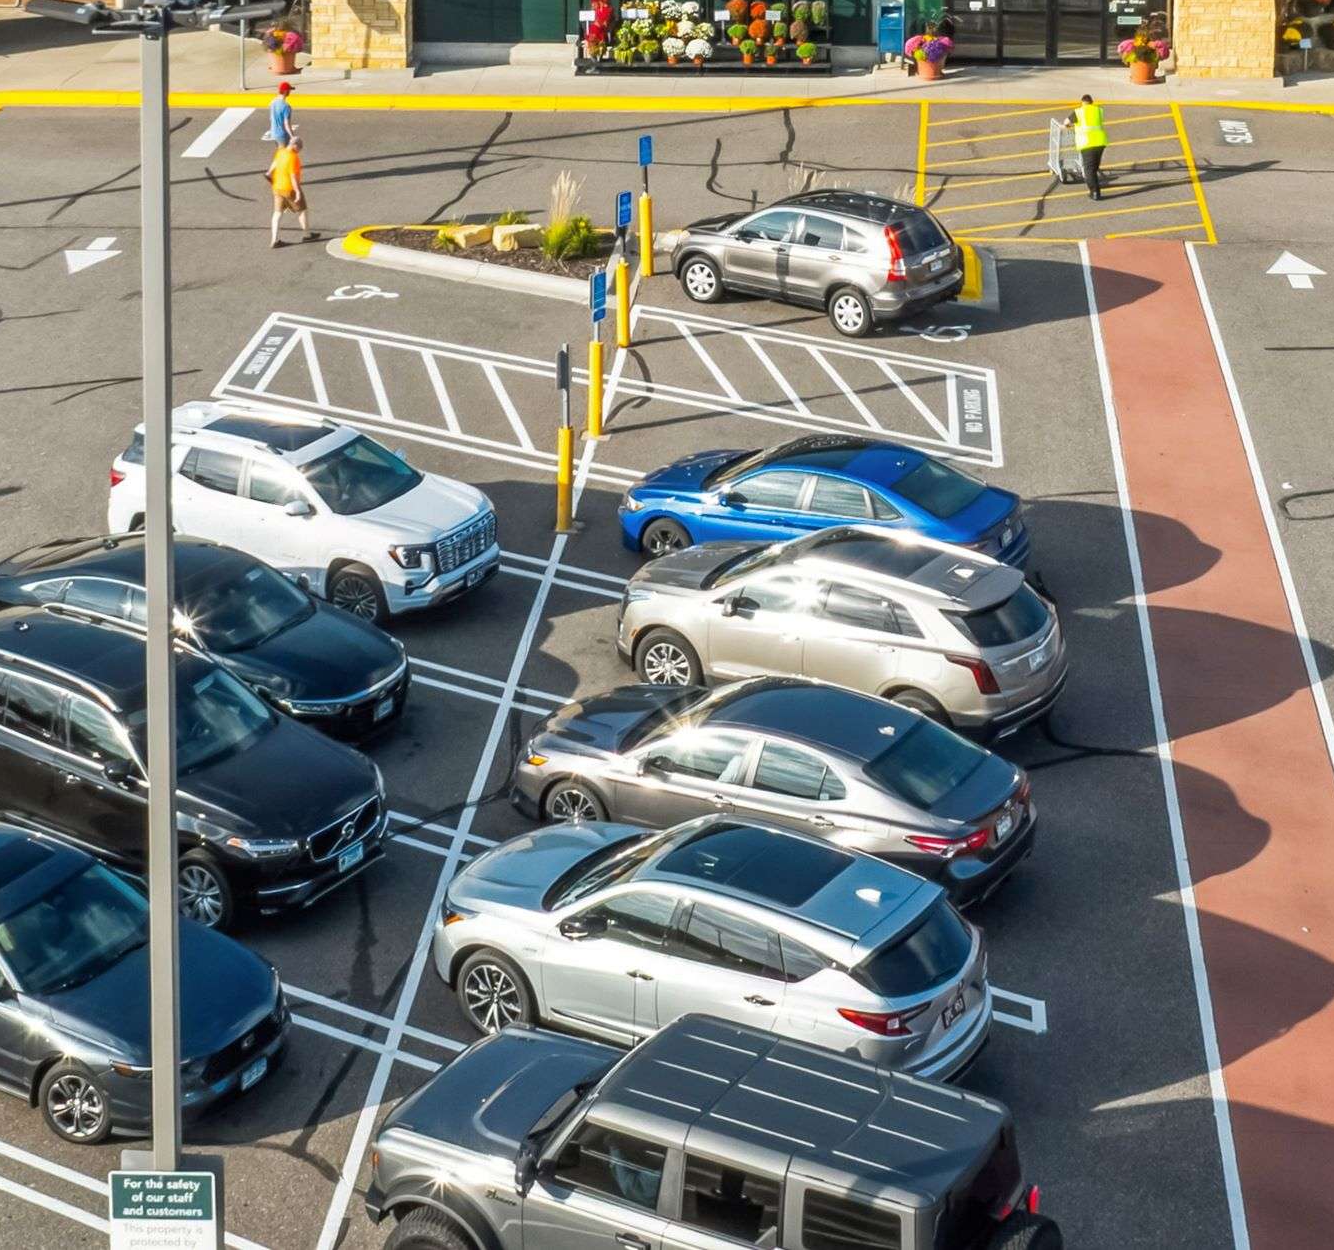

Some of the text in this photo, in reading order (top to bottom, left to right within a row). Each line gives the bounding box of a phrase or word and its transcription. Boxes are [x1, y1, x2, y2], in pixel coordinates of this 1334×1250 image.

[962, 389, 983, 420] PARKING
[123, 1178, 201, 1192] For the safety
[131, 1191, 194, 1203] of our staff
[123, 1205, 203, 1217] and customers
